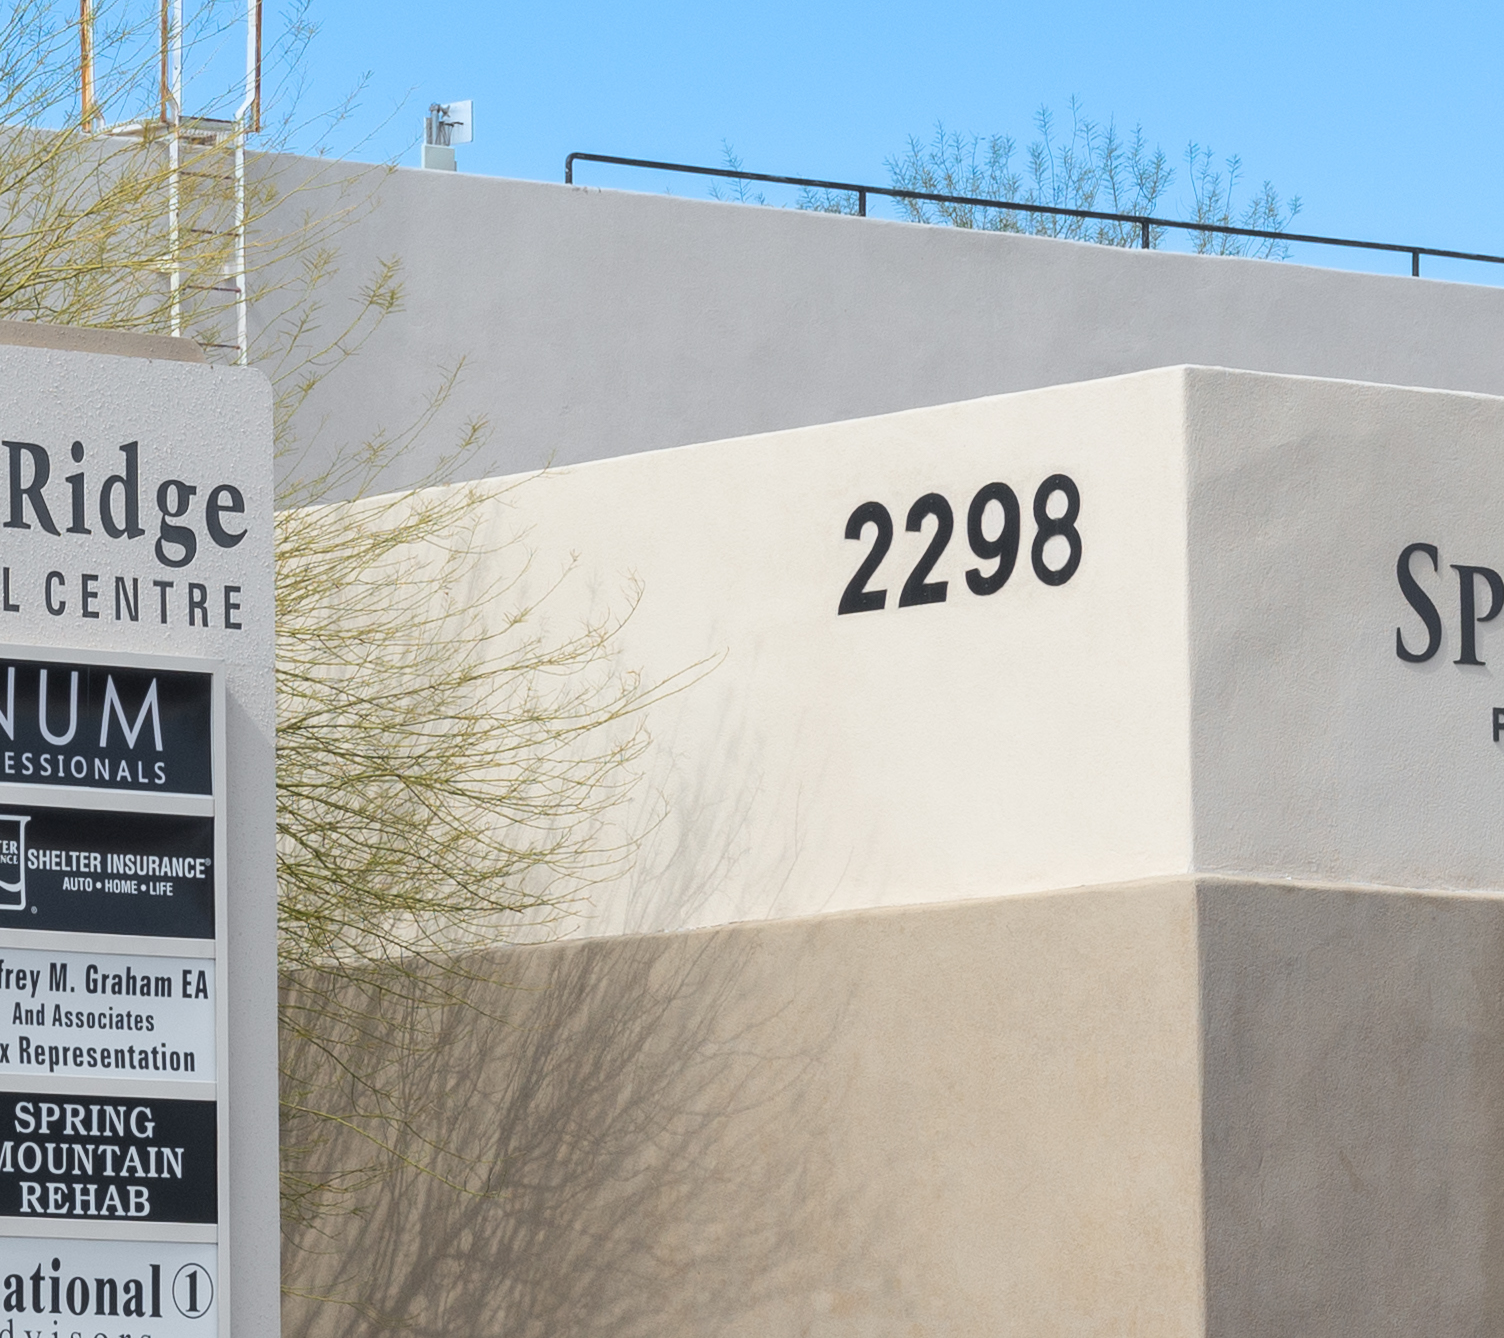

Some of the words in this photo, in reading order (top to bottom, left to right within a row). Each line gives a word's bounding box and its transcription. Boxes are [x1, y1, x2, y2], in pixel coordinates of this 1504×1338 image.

[2, 439, 249, 567] Ridge
[837, 473, 1083, 615] 2298
[44, 570, 244, 631] CENTRE
[27, 849, 102, 873] SHELTER
[63, 876, 93, 892] AUTO
[104, 879, 138, 895] HOME
[149, 882, 174, 896] LIFE
[49, 962, 76, 993] M.
[85, 964, 172, 998] Graham
[181, 969, 209, 1000] EA
[12, 1002, 45, 1027] And
[51, 1003, 155, 1032] Associates
[18, 1035, 196, 1073] Representation
[14, 1101, 156, 1140] SPRING
[18, 1180, 152, 1219] REHAB
